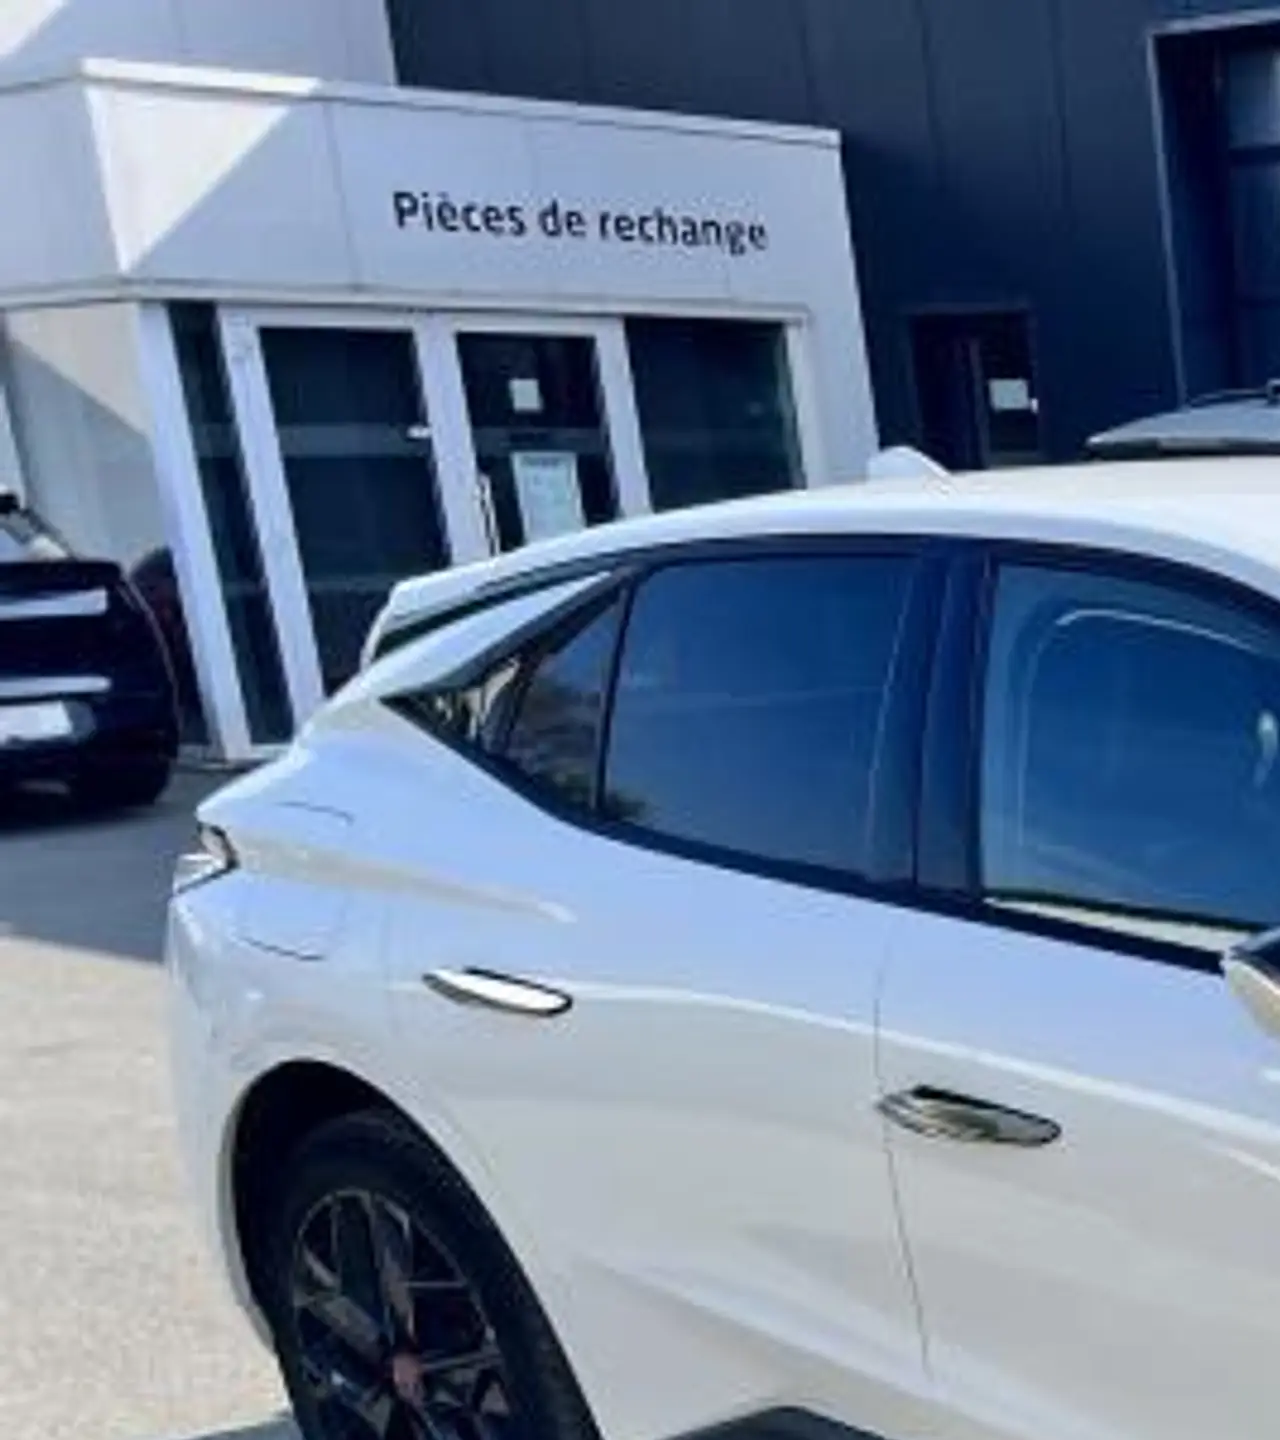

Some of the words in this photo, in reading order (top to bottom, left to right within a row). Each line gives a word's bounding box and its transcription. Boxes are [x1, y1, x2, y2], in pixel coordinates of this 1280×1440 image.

[393, 191, 527, 236] Pièces
[538, 199, 586, 238] de
[599, 207, 768, 256] rechange
